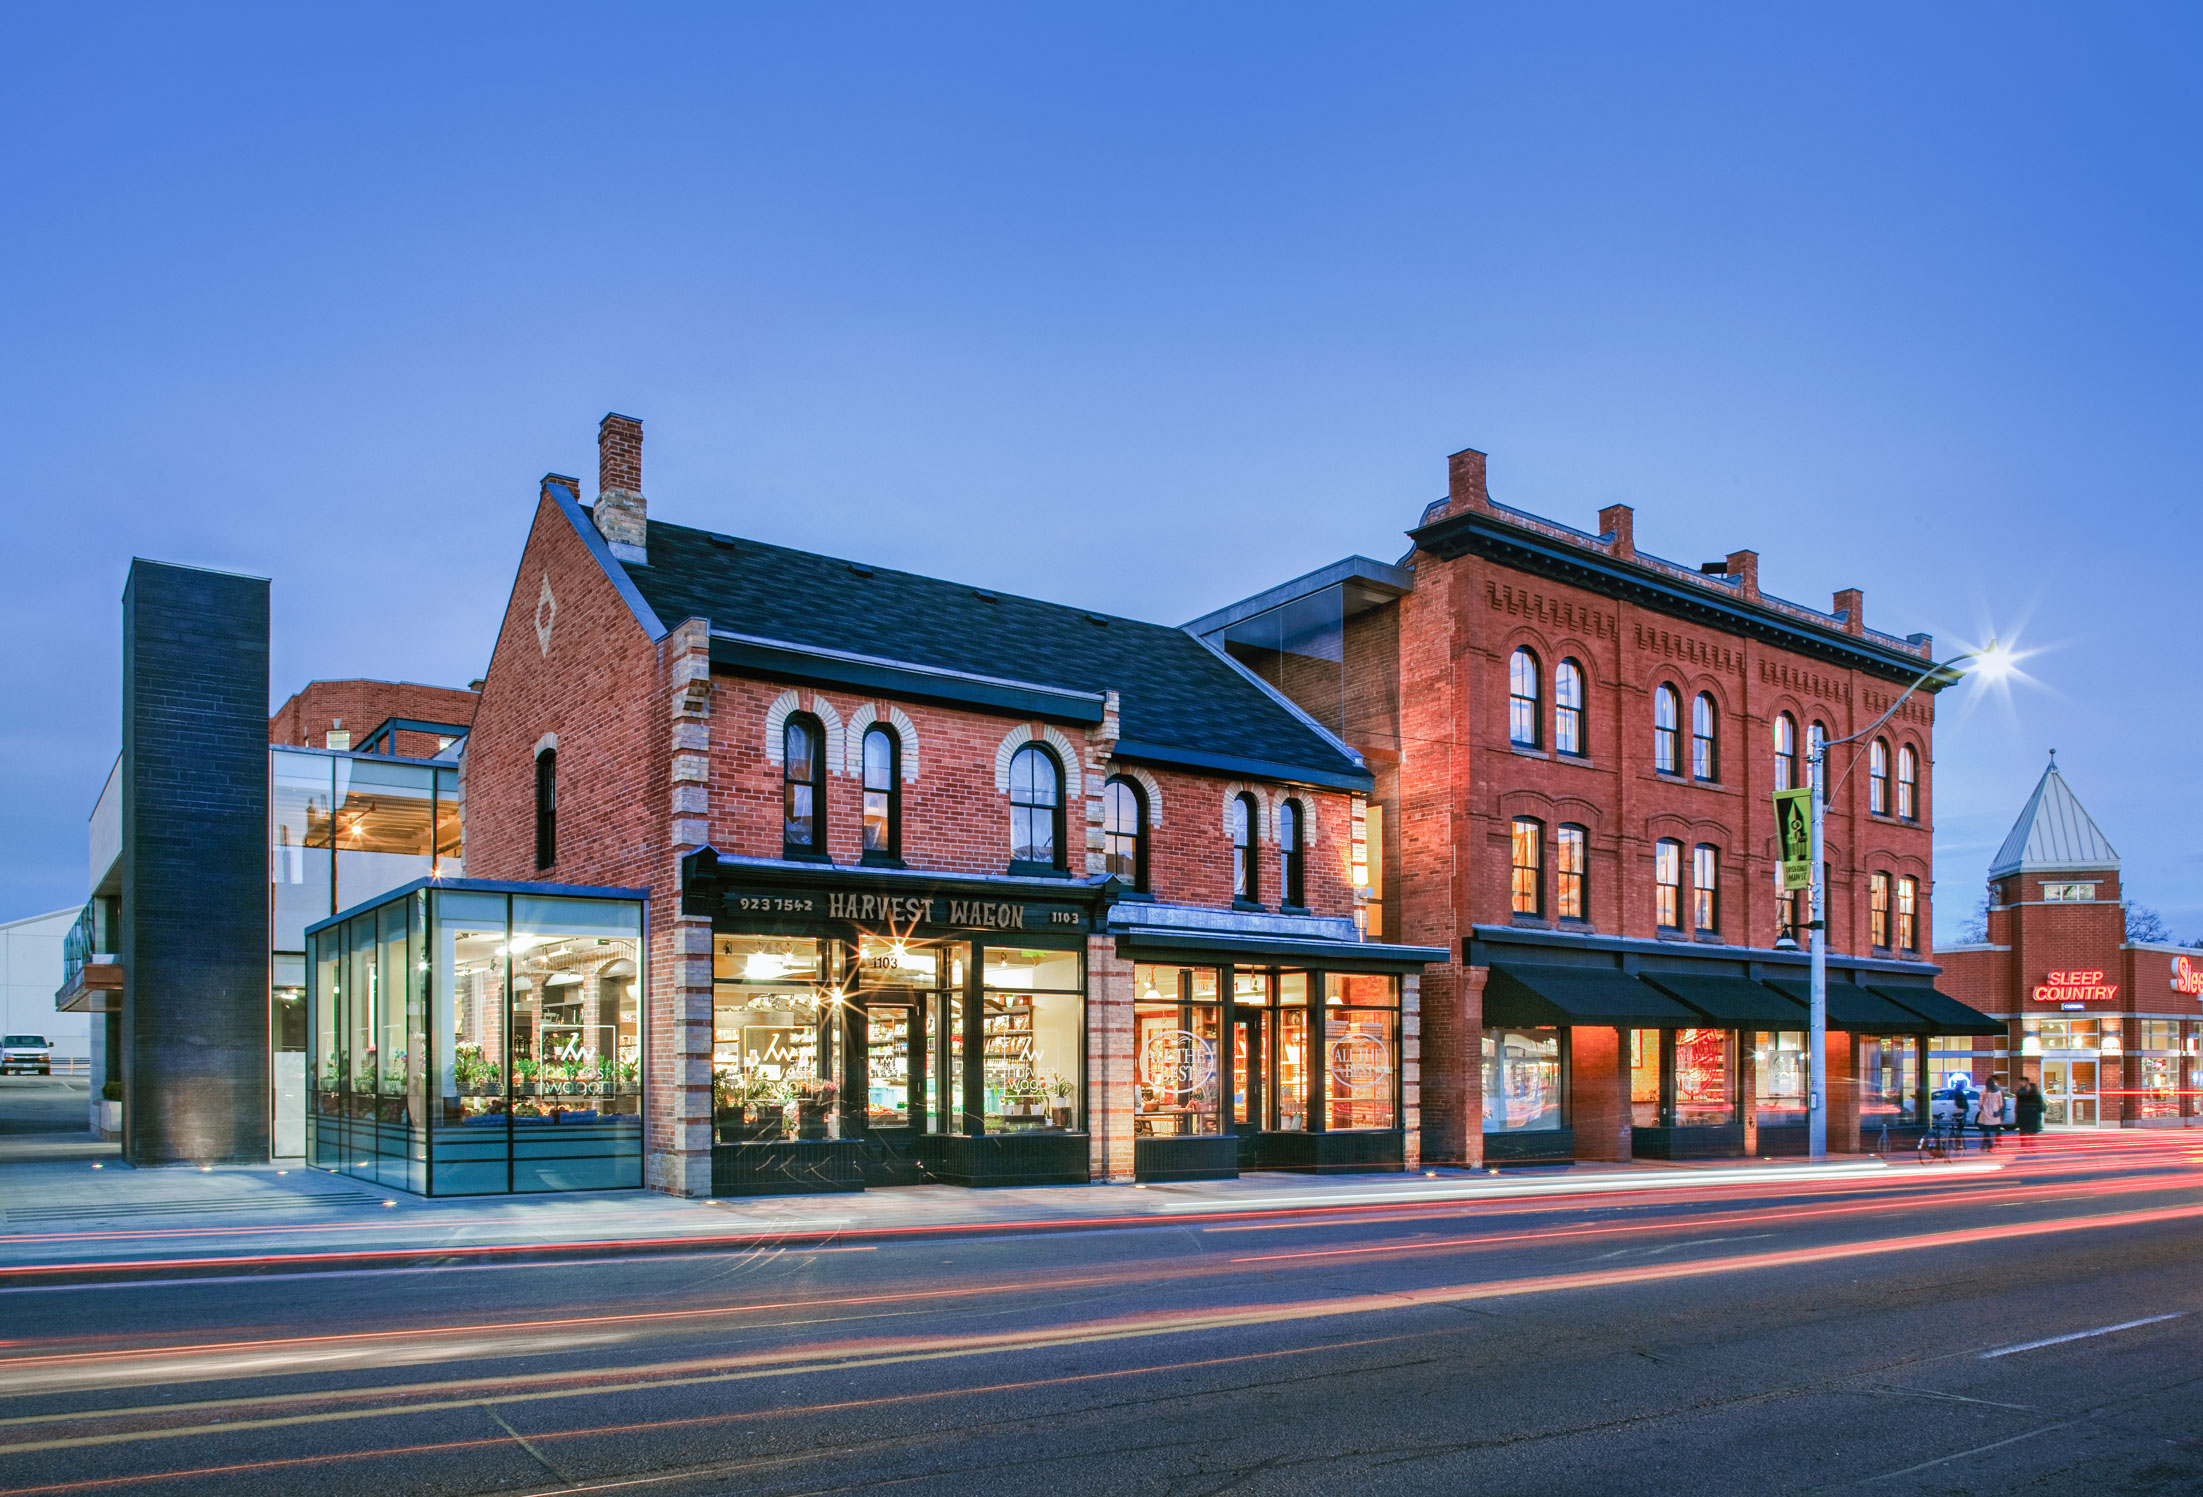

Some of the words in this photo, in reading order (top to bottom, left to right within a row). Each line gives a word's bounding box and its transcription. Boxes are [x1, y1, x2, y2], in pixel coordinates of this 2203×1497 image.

[740, 897, 771, 911] 923
[829, 892, 934, 923] HARVEST
[949, 900, 1024, 929] WAGON
[1051, 911, 1079, 925] 1103
[871, 956, 898, 969] 1103
[2048, 970, 2104, 986] SLEEP
[2033, 985, 2119, 1001] COUNTRY
[1176, 1048, 1206, 1064] THE
[1335, 1048, 1353, 1063] ALL
[1162, 1065, 1196, 1082] BEST
